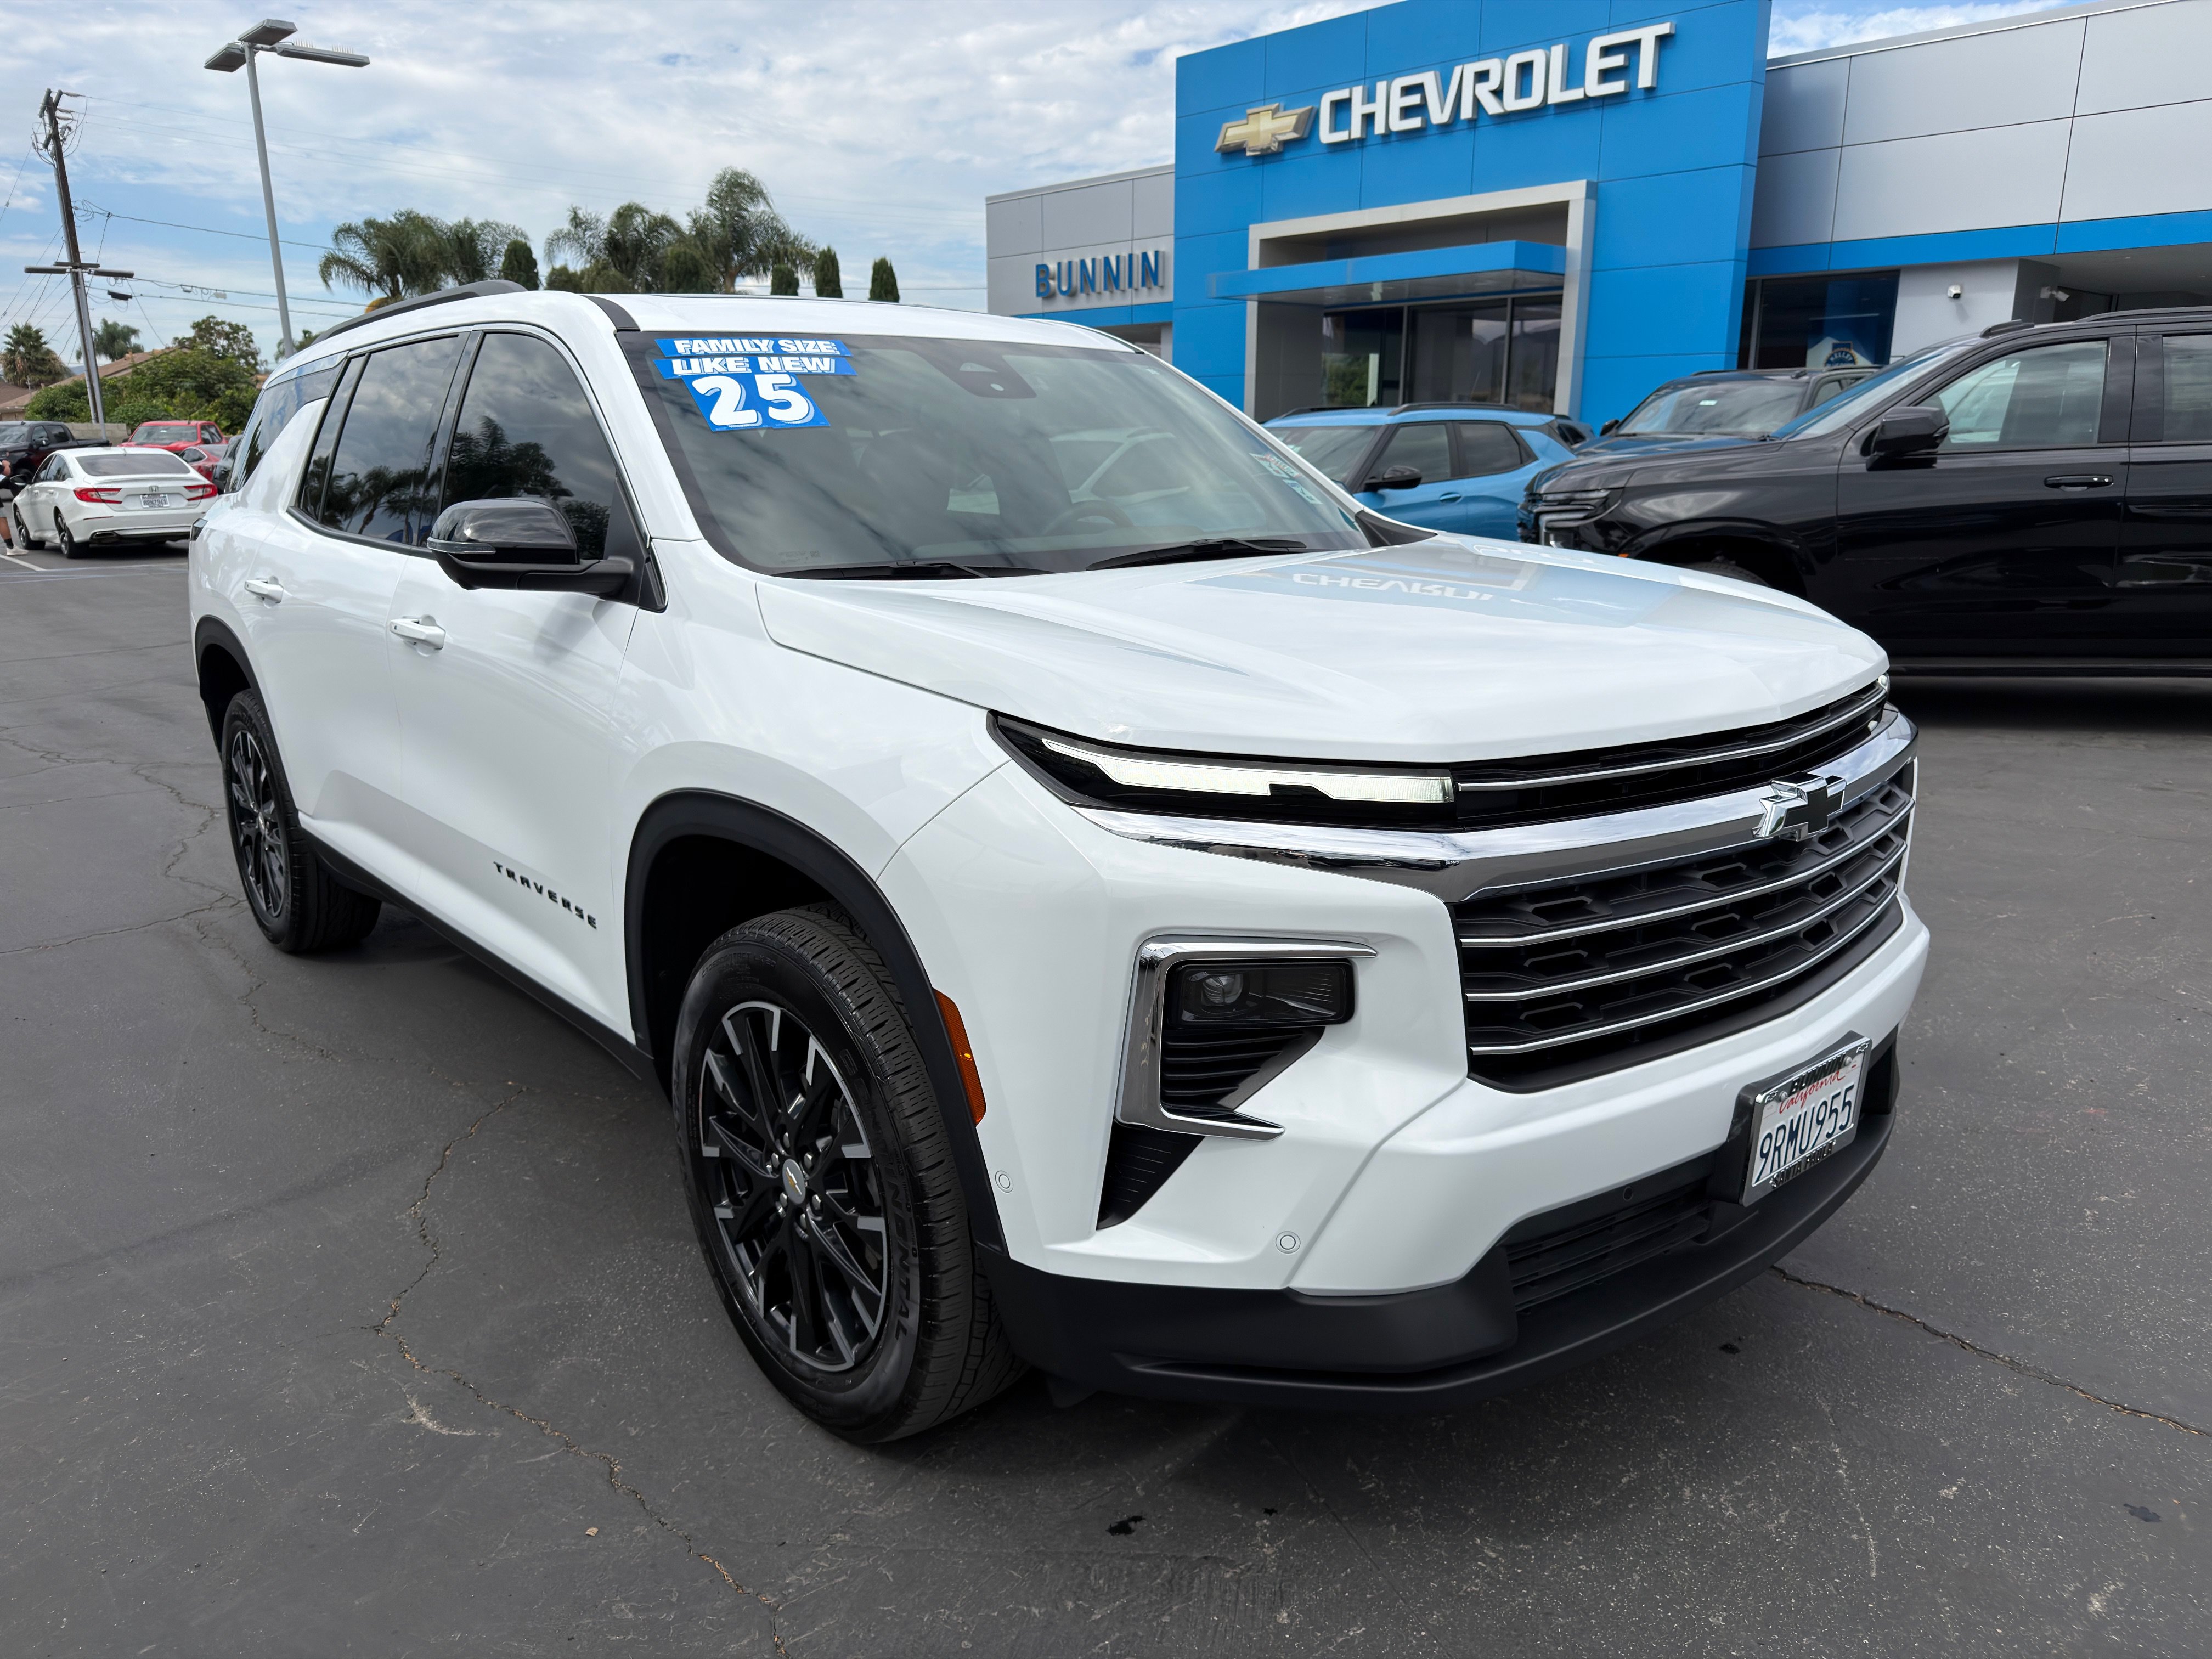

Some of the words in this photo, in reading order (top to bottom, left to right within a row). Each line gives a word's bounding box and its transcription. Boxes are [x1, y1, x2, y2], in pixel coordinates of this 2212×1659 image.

[1319, 21, 1676, 144] CHEVROLET
[1035, 250, 1163, 298] BUNNIN
[671, 357, 752, 376] LIKE
[757, 357, 836, 374] NEW
[674, 338, 774, 354] FAMILY
[778, 339, 840, 355] SIZE
[691, 373, 815, 428] 25
[493, 861, 597, 929] TRAVERSE
[1779, 1070, 1846, 1114] California
[1788, 1052, 1847, 1096] BUNNIN
[1754, 1083, 1855, 1184] 9RMU955
